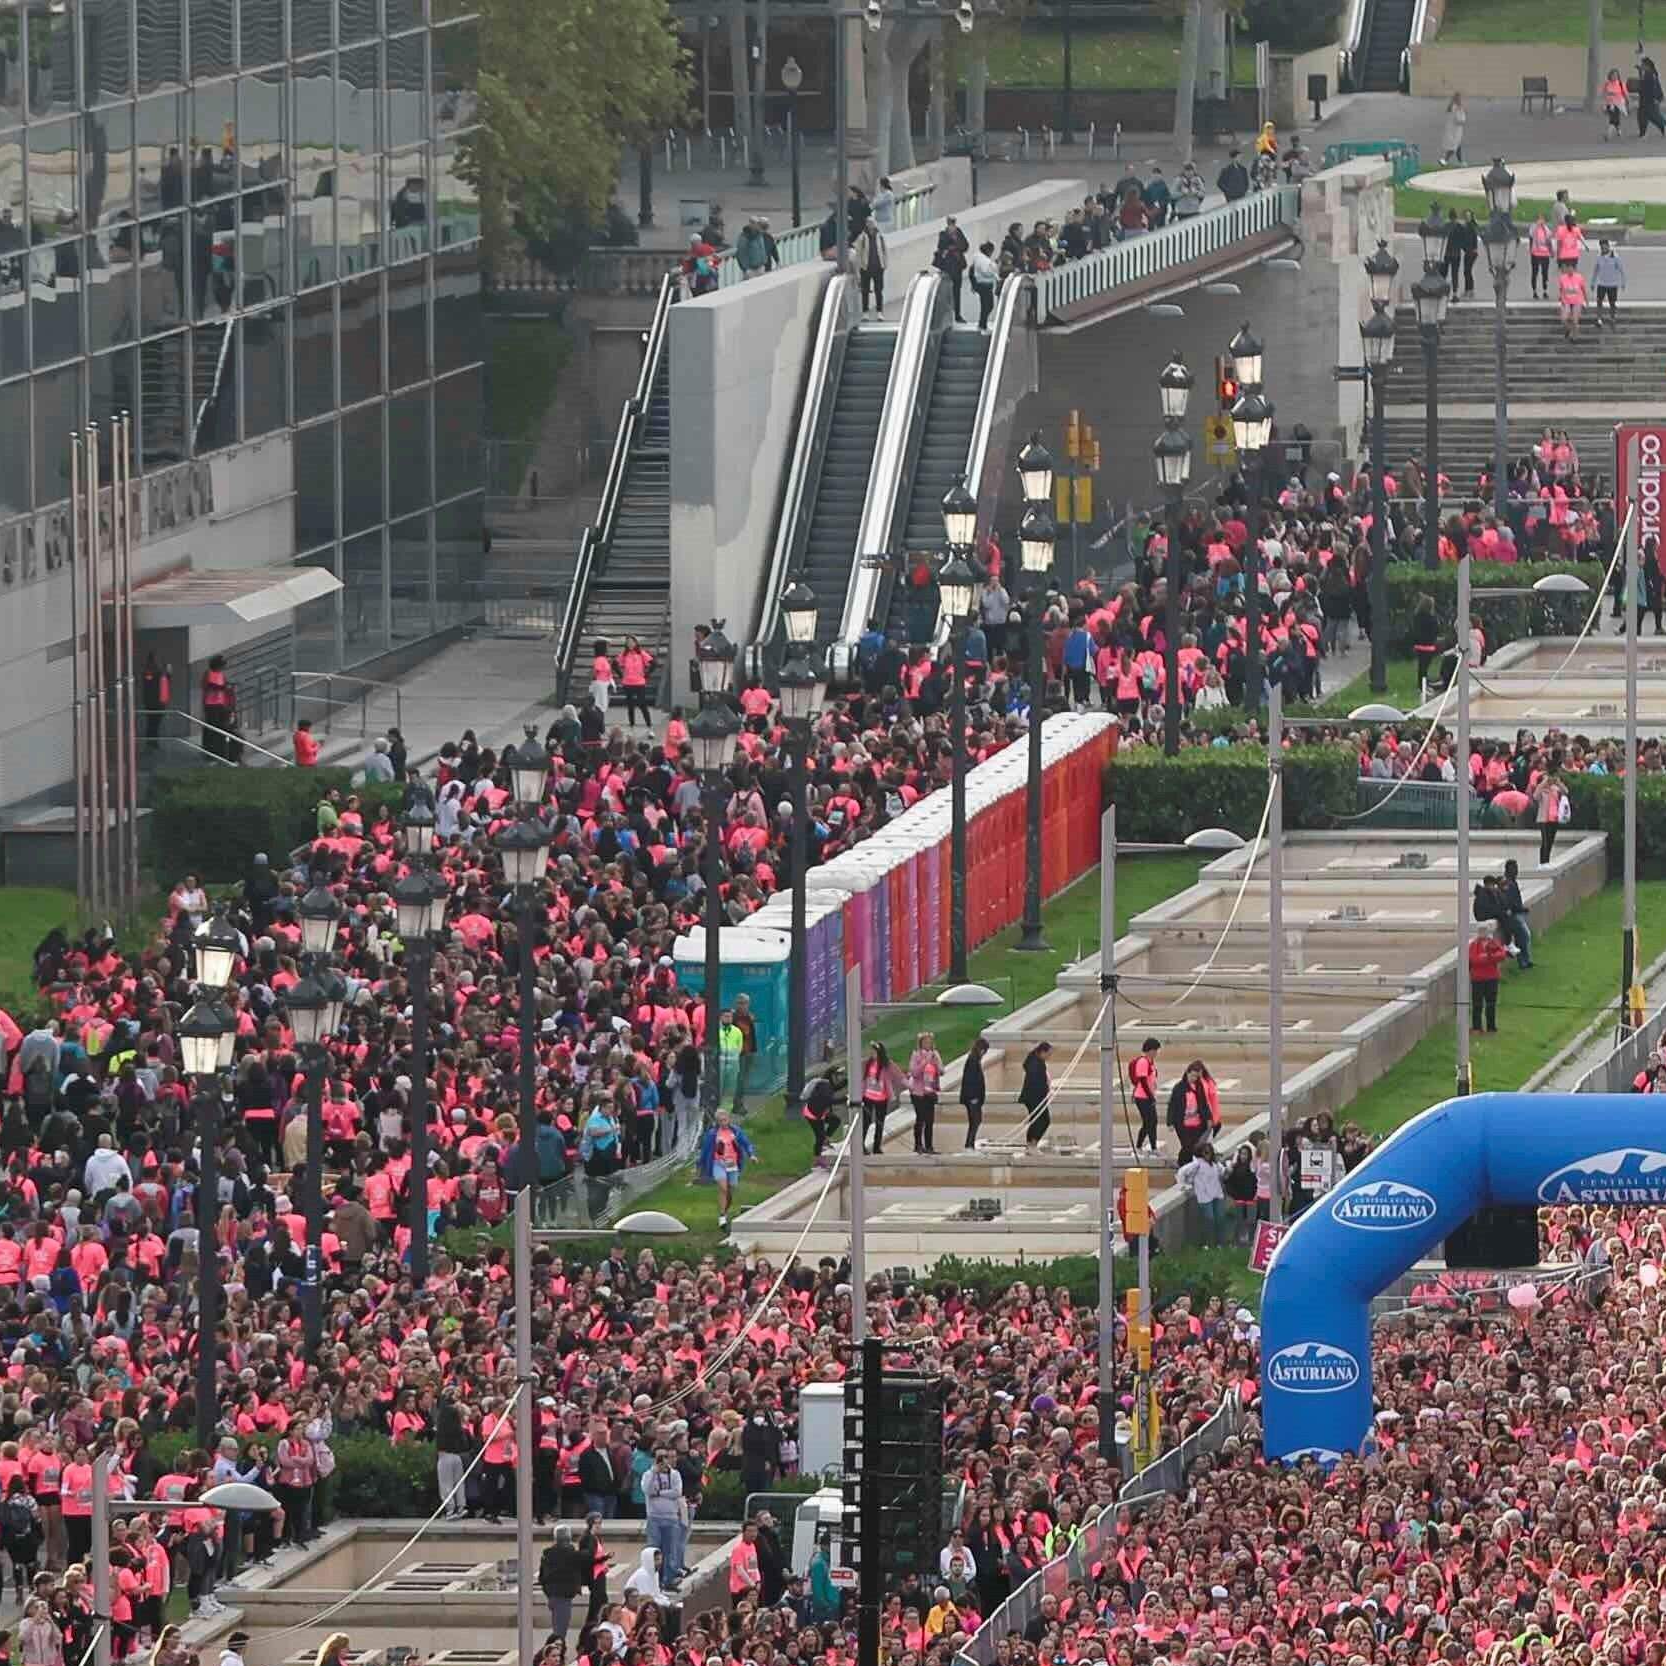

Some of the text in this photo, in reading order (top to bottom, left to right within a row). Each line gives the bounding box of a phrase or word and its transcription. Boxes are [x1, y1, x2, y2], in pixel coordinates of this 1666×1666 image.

[1581, 1176, 1638, 1186] CENTRAL
[1339, 1199, 1428, 1217] ASTURIANA
[1274, 1361, 1354, 1380] ASTURIANA
